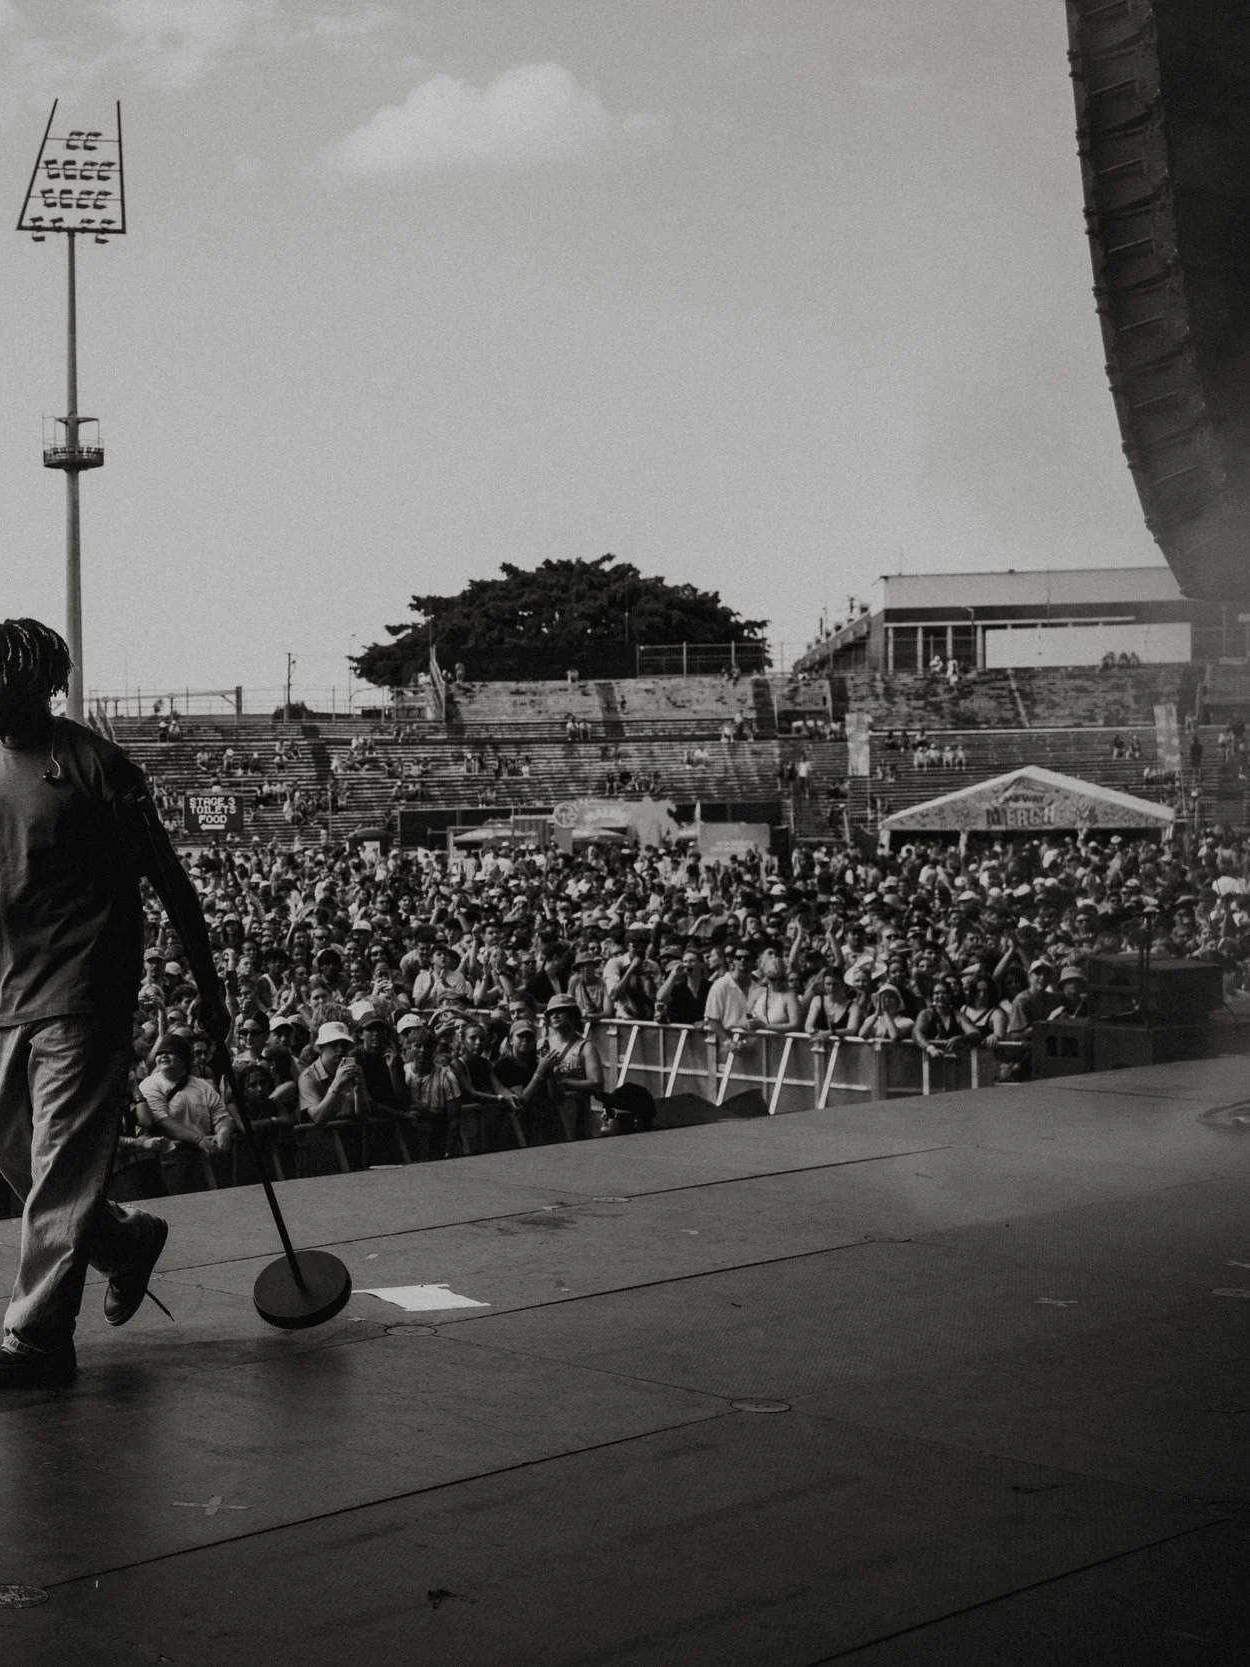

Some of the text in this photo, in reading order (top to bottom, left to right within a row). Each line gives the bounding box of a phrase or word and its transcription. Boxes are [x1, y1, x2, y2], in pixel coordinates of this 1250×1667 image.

[189, 797, 235, 806] STAGE 3
[189, 805, 237, 814] TOILETS
[198, 814, 228, 824] FOOD
[986, 807, 1055, 826] MERCH
